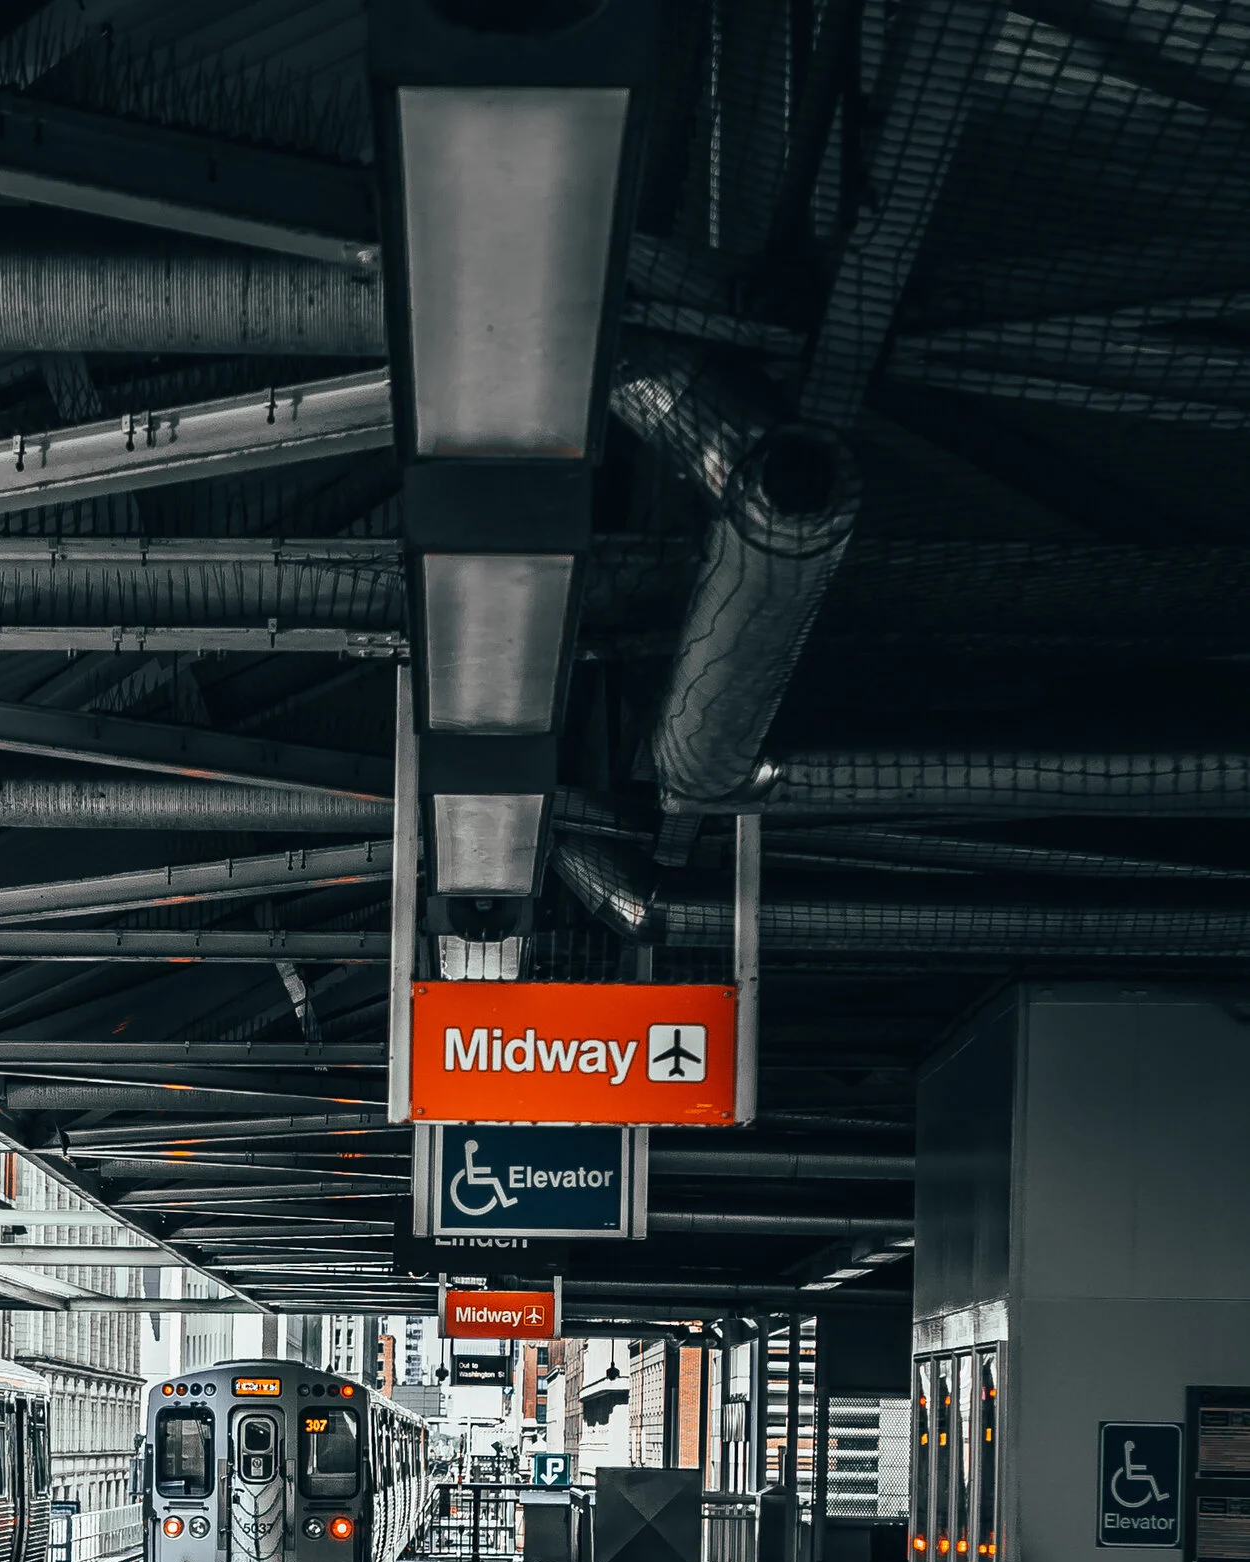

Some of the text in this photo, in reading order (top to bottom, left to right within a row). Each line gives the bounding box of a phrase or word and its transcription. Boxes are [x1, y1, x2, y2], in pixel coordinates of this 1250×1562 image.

[444, 1027, 638, 1086] Midway
[508, 1165, 614, 1188] Elevator
[455, 1306, 523, 1327] Midway
[458, 1371, 496, 1380] Washington
[305, 1418, 328, 1433] 307
[243, 1523, 274, 1534] 5037
[1104, 1512, 1175, 1530] Elevator
